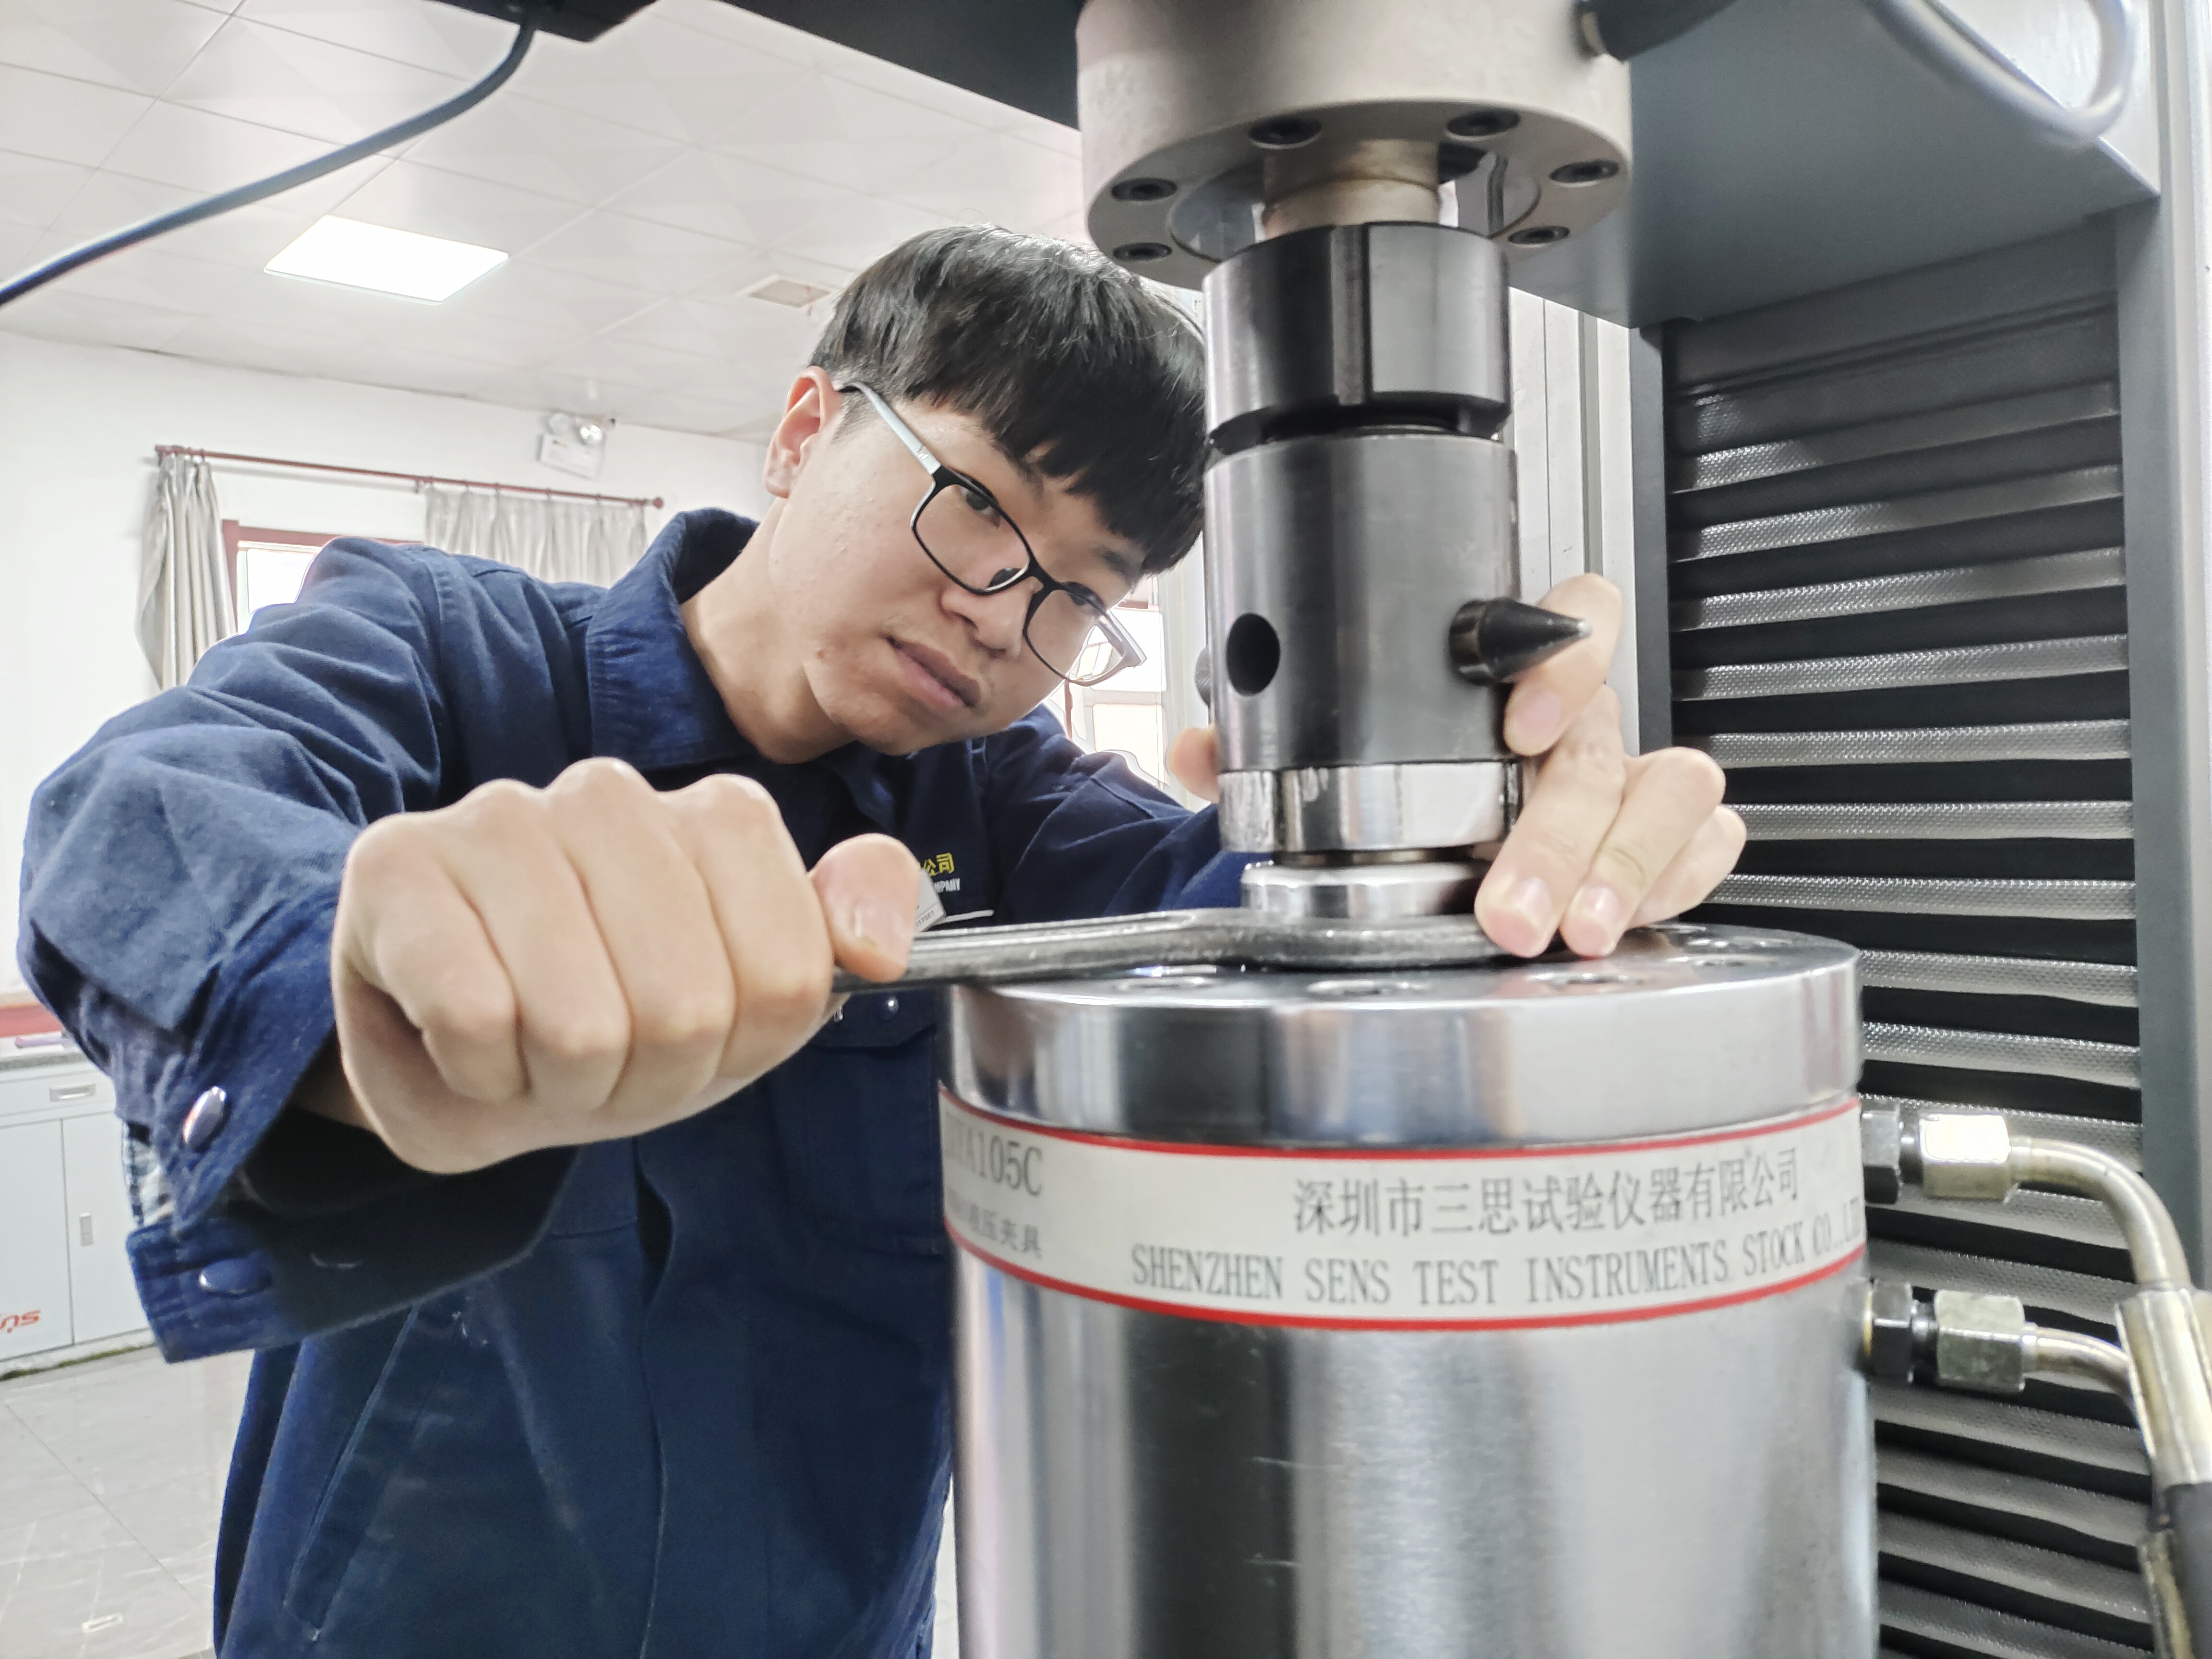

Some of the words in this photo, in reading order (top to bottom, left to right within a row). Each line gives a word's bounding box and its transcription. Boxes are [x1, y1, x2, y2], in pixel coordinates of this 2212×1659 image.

[1295, 1147, 1799, 1237] 深圳市三思试验仪器有限公司
[1132, 1244, 1284, 1300] SHENZHEN
[1305, 1258, 1391, 1304] SENS
[1413, 1259, 1500, 1305] TEST
[1526, 1238, 1728, 1304] INSTRUMENTS
[1742, 1221, 1804, 1277] STOCK
